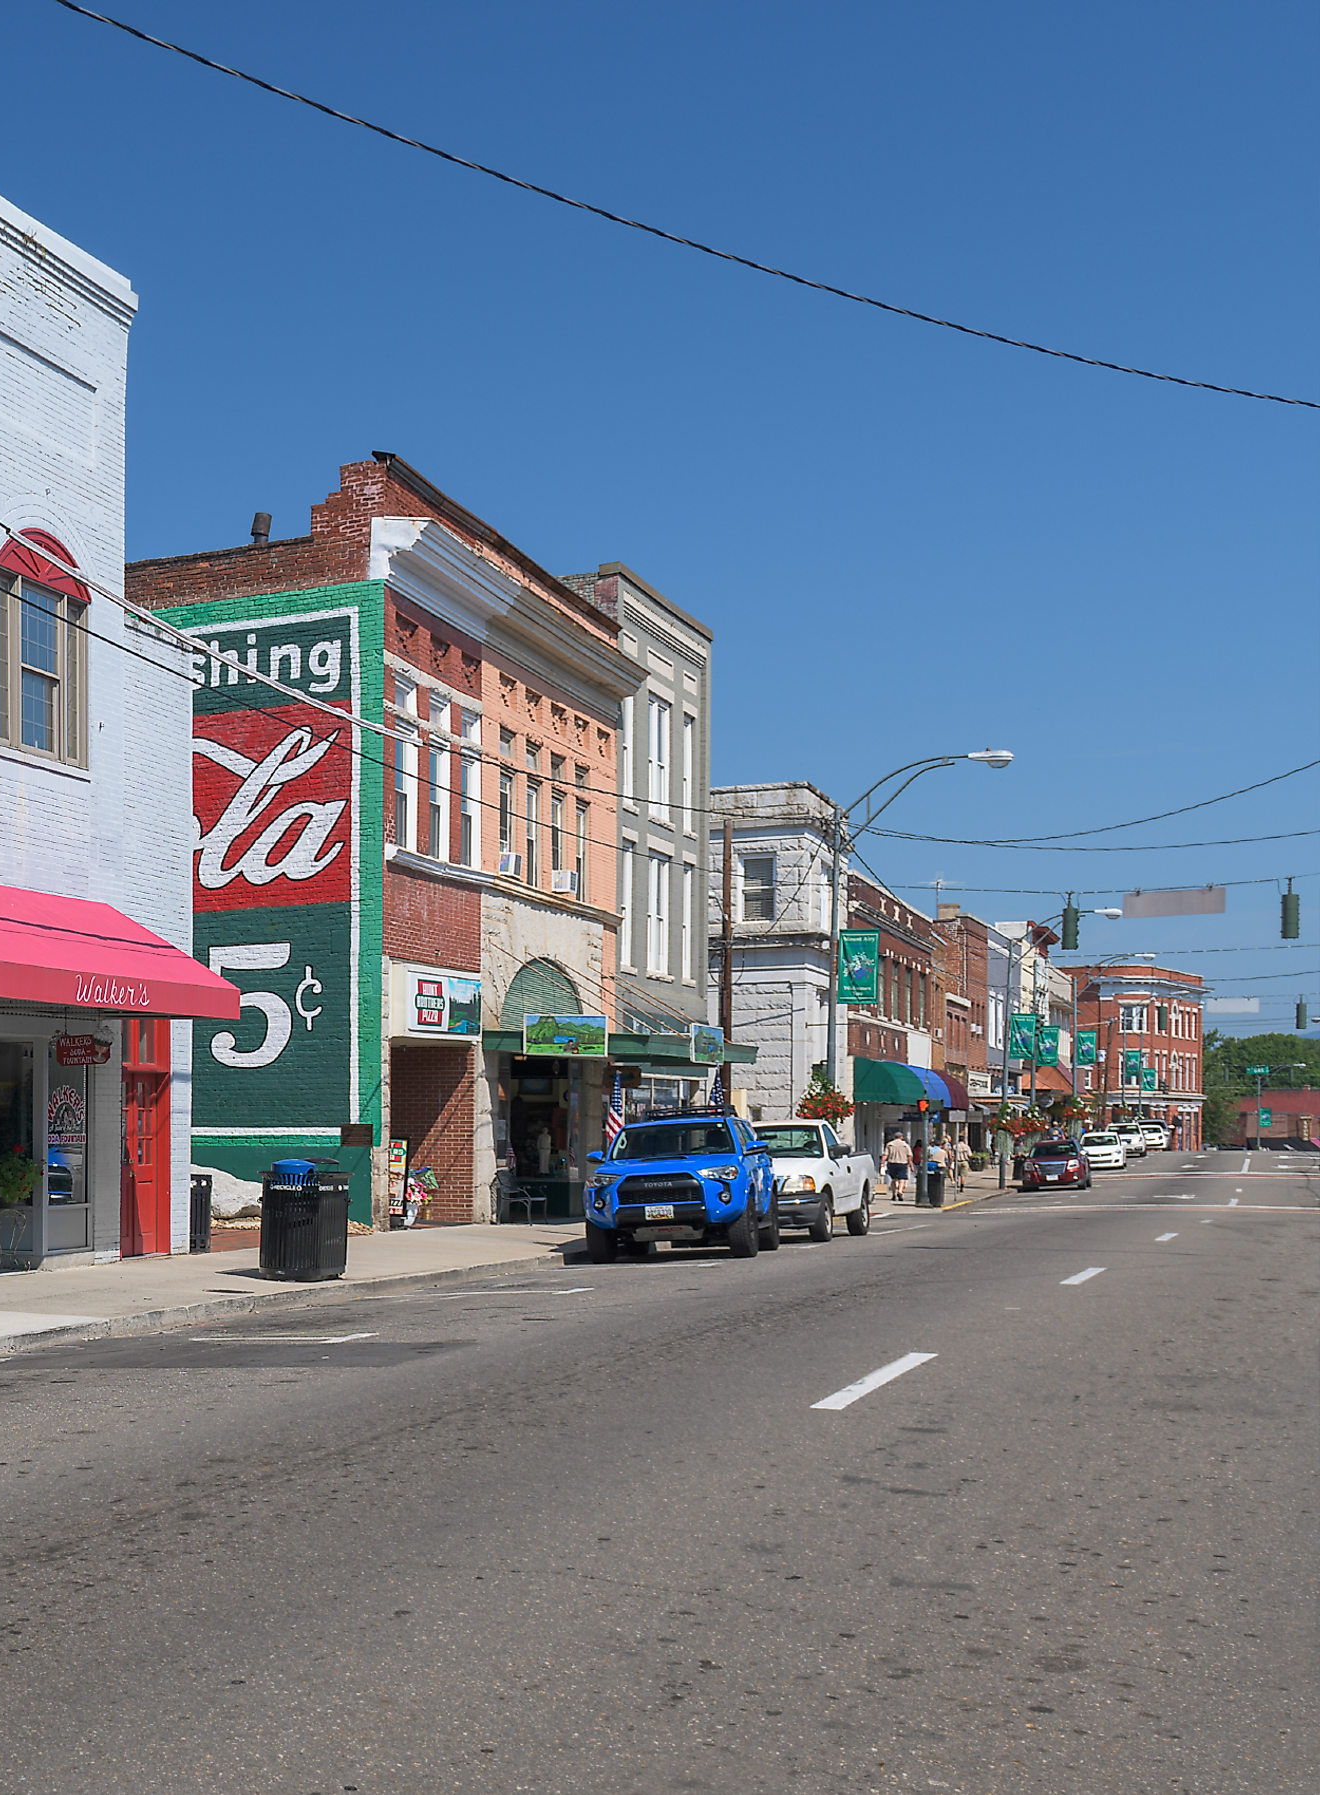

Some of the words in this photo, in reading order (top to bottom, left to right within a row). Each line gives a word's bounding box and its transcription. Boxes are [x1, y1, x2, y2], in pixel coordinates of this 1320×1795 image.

[75, 974, 150, 1006] Walker's
[59, 1035, 92, 1047] WALKERS
[63, 1055, 92, 1065] FOUNTAIN
[48, 1134, 59, 1144] ODA
